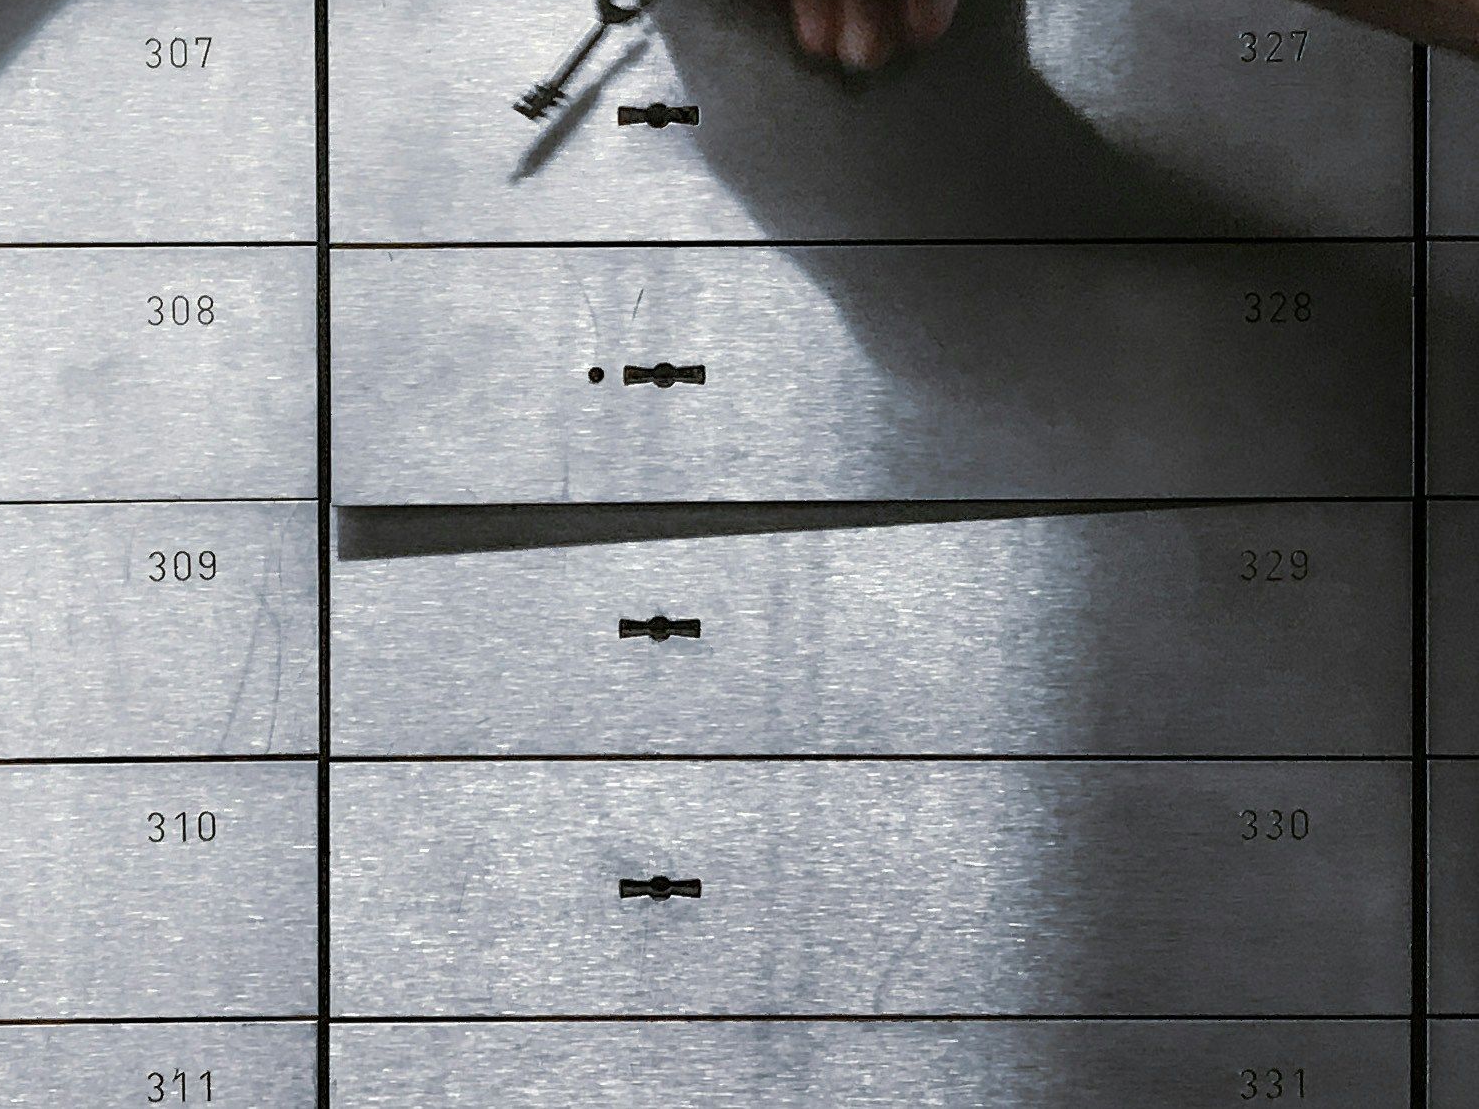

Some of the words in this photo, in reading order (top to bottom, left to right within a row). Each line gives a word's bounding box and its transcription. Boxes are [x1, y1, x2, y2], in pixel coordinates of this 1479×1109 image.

[144, 36, 213, 69] 307
[1239, 30, 1309, 63] 327
[146, 294, 215, 327] 308
[1244, 291, 1312, 324] 328
[148, 550, 217, 583] 309
[1240, 549, 1309, 582] 329
[146, 810, 216, 843] 310
[1239, 809, 1310, 841] 330
[147, 1067, 213, 1103] 311
[1239, 1068, 1305, 1100] 331
